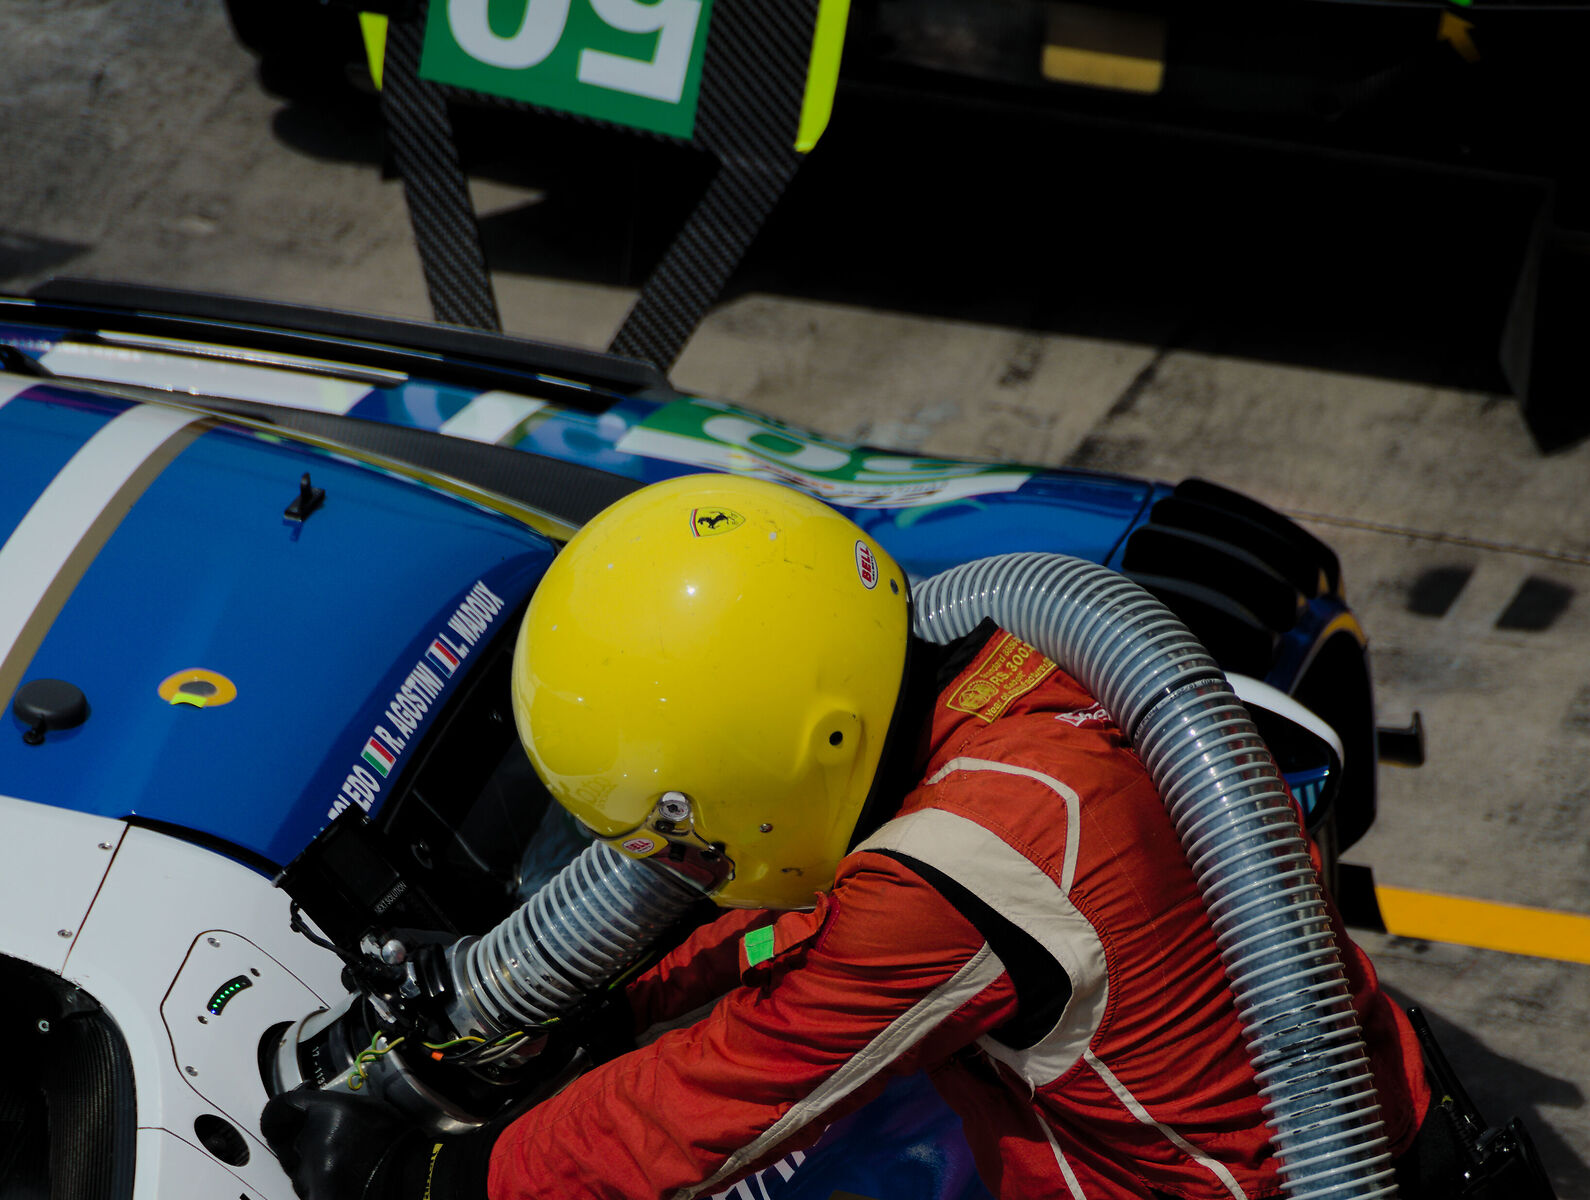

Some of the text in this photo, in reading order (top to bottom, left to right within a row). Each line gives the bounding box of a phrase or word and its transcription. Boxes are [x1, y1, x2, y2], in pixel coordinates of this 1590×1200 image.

[859, 547, 872, 583] BELL
[447, 580, 505, 646] WADOUX
[439, 632, 470, 660] L.
[384, 660, 445, 741] AGOSTINI
[374, 725, 406, 755] R.
